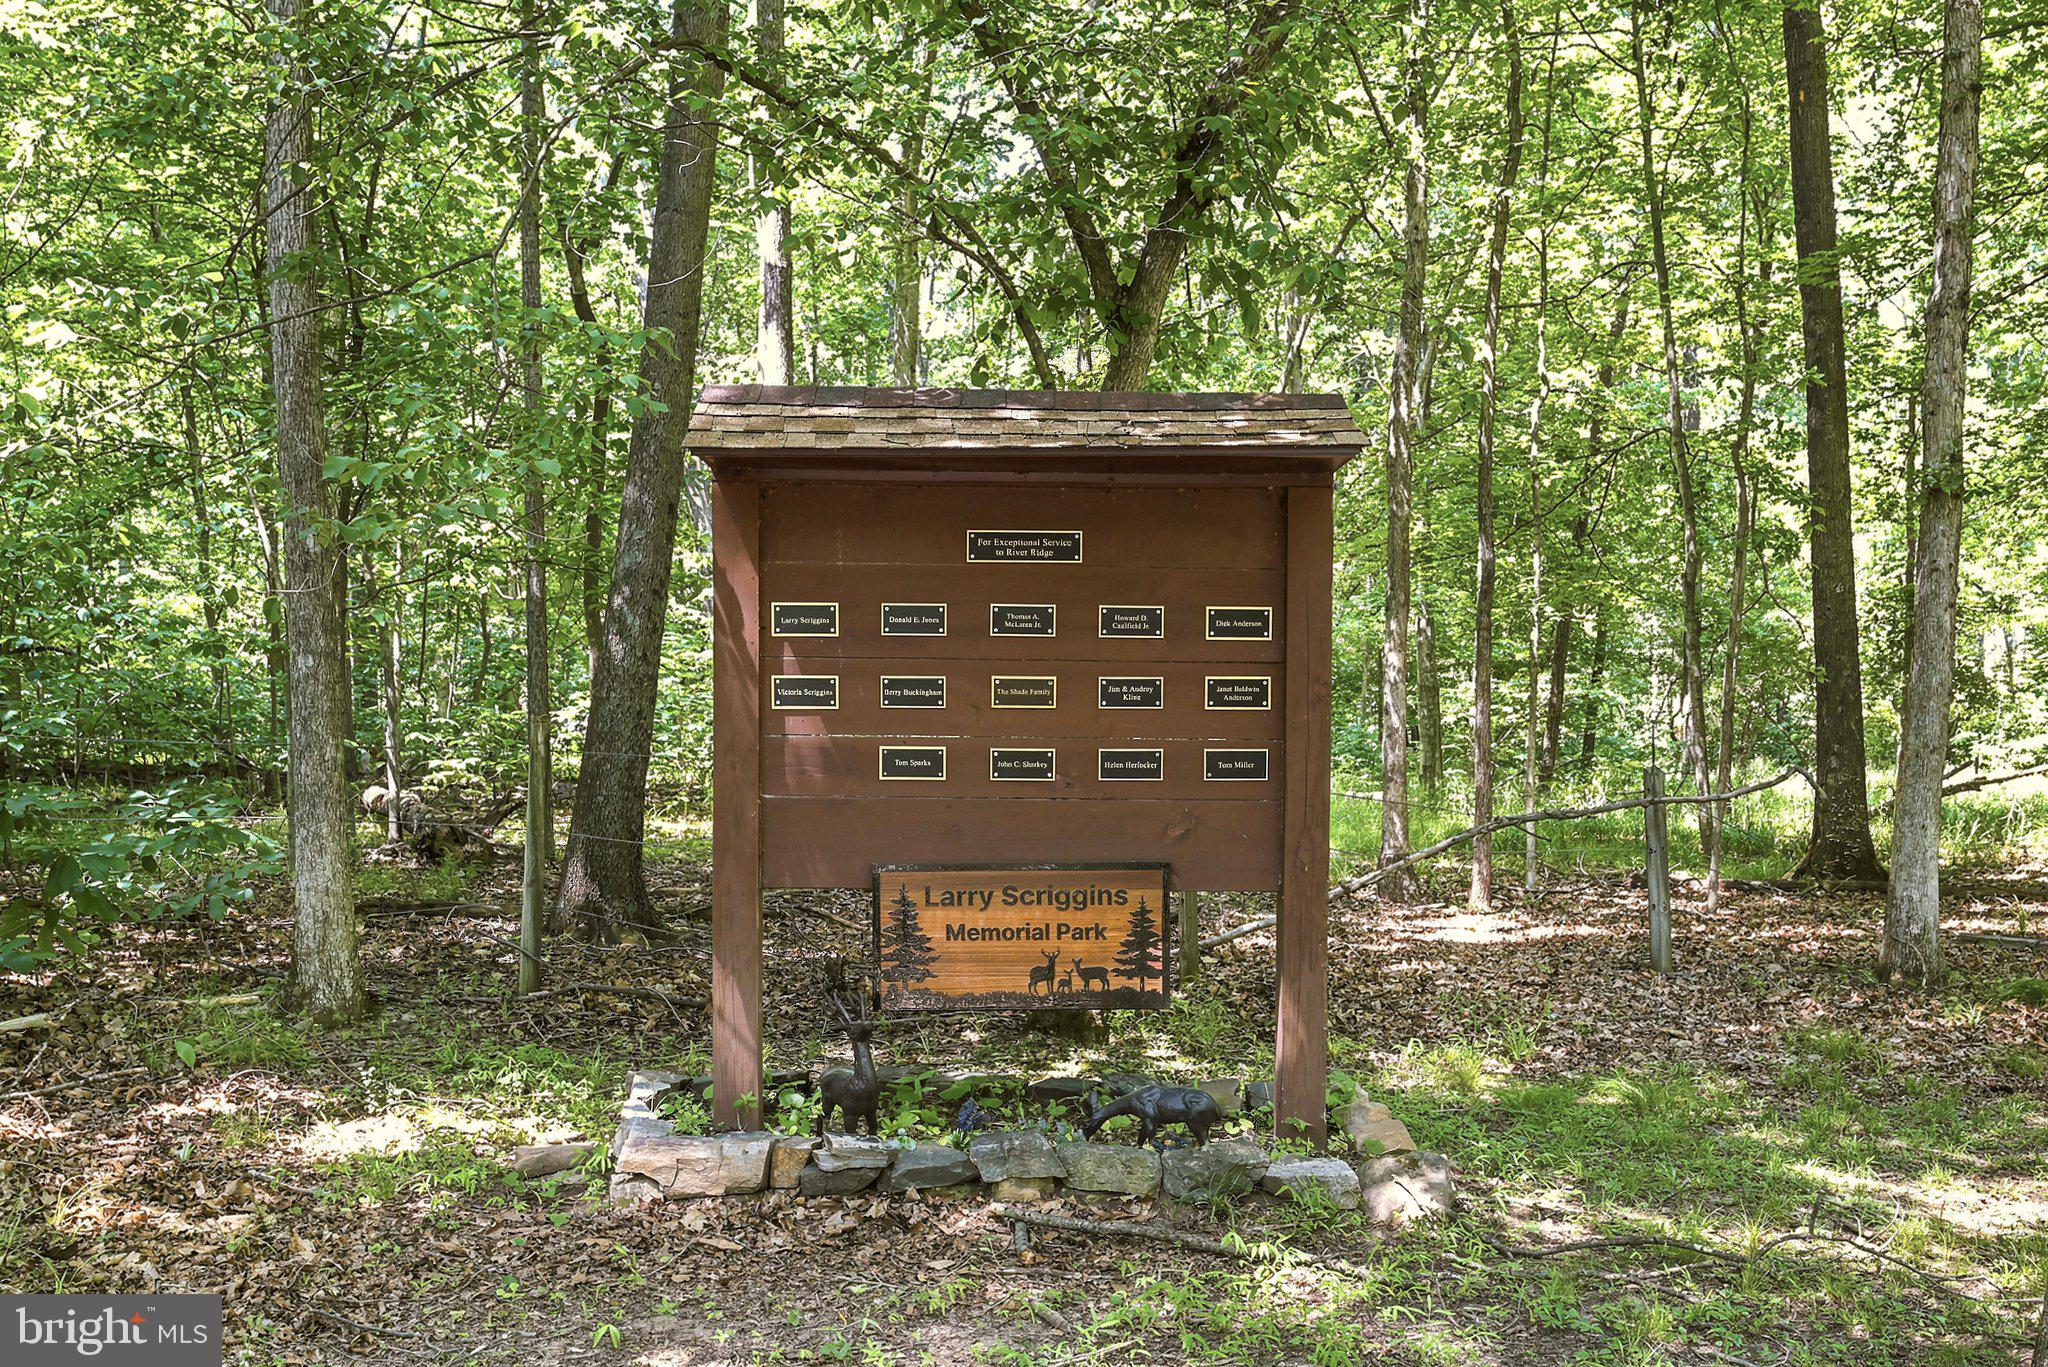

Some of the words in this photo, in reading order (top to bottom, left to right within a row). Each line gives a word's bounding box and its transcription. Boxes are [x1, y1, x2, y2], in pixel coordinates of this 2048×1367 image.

[978, 538, 991, 546] For
[994, 538, 1040, 548] Exceptional
[1042, 538, 1072, 546] Service
[1030, 549, 1054, 558] Ridge
[781, 616, 799, 624] Larry
[800, 616, 830, 625] Scriggins
[804, 688, 833, 697] Scriggins
[910, 759, 931, 767] Sparks
[924, 885, 994, 912] Larry
[1001, 884, 1128, 911] Scriggins
[945, 923, 1050, 941] Memorial
[1056, 923, 1108, 941] Park
